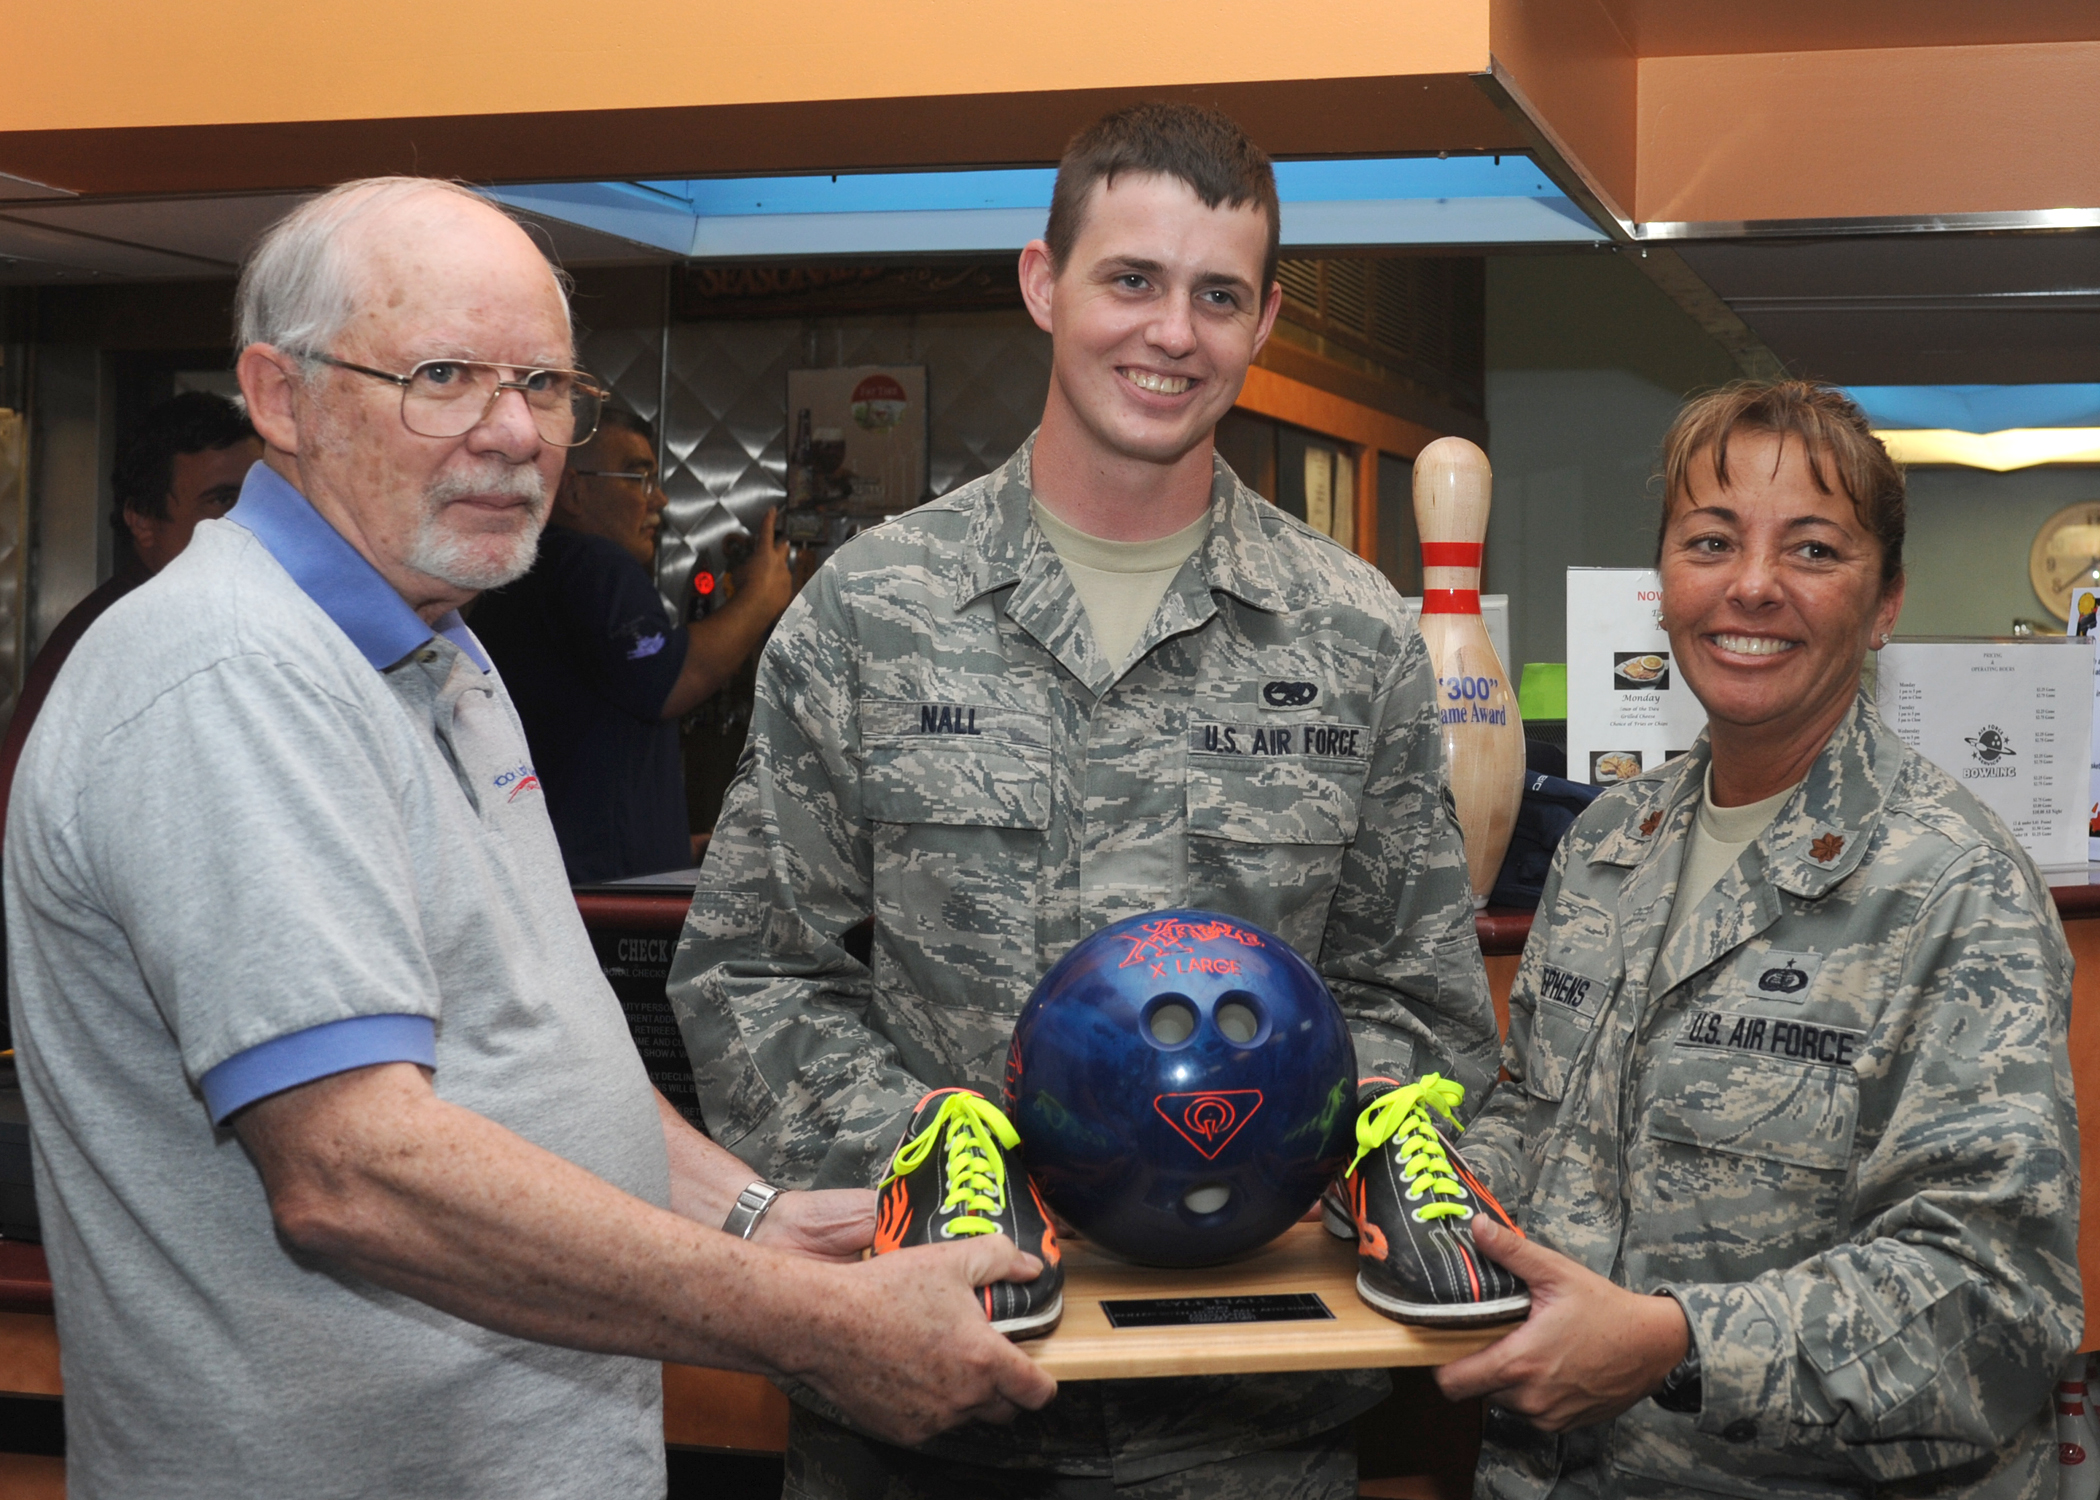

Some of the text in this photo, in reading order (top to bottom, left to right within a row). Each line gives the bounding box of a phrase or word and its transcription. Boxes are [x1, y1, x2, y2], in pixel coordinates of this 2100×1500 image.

[1621, 692, 1660, 704] Monday
[1441, 701, 1506, 726] ame Award
[921, 705, 981, 735] NALL
[1204, 725, 1359, 756] U.S. AIR FORCE
[1963, 766, 2016, 779] BOWLING
[617, 938, 668, 963] CHECK
[632, 968, 667, 978] CHECKS
[1150, 957, 1242, 979] X LARGE
[1541, 966, 1590, 1007] EPHENS
[623, 1003, 640, 1011] UTY
[626, 1014, 653, 1023] RRENT
[635, 1025, 676, 1035] RETIREES
[653, 1038, 671, 1047] AND
[1689, 1013, 1854, 1065] U.S. AIR FORCE
[643, 1049, 669, 1058] SHOW
[661, 1072, 693, 1082] DECLIN
[669, 1084, 688, 1093] WILL
